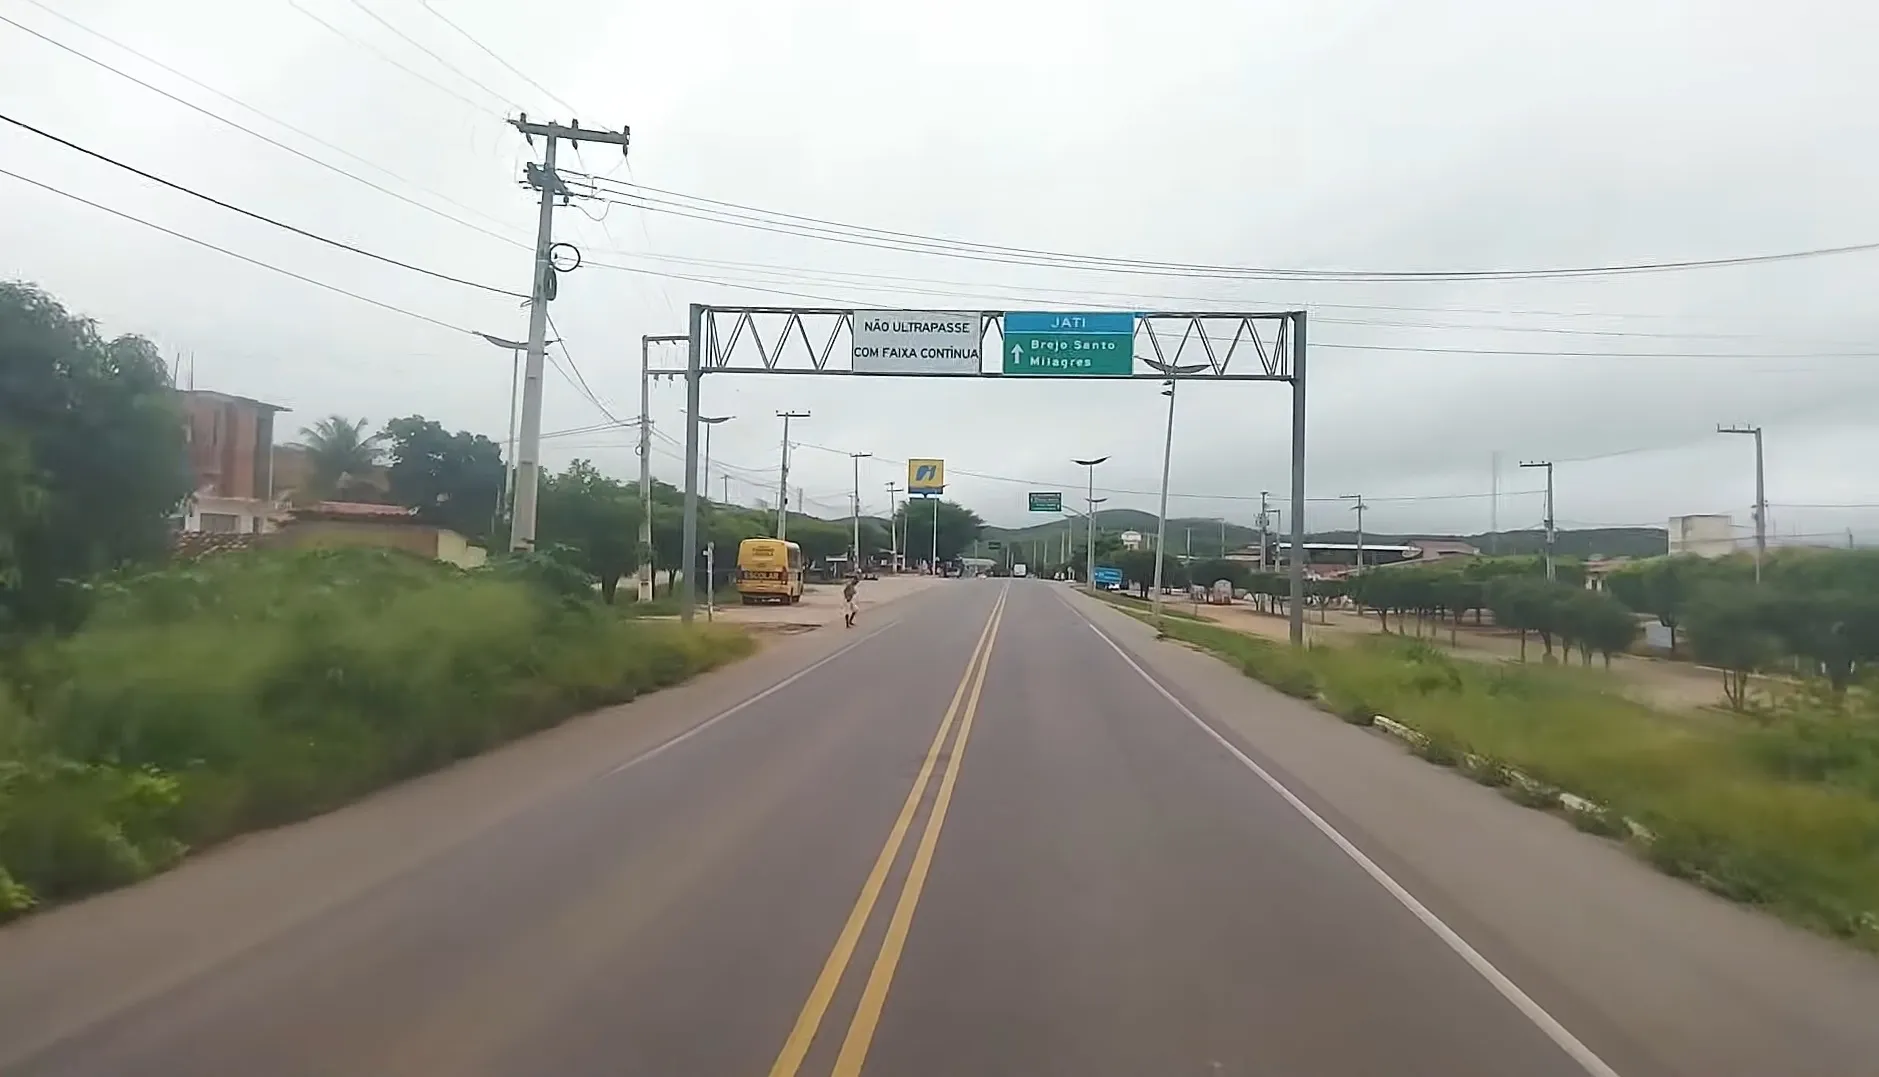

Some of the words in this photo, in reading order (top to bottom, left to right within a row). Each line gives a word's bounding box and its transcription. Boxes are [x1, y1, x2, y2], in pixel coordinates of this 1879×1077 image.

[864, 318, 889, 333] NÃO
[893, 321, 970, 334] ULTRAPASSE
[1050, 315, 1087, 329] JATI
[1031, 338, 1066, 351] Brejo
[1074, 340, 1116, 351] Santo
[854, 346, 878, 359] COM
[882, 346, 918, 359] FAIXA
[1030, 356, 1092, 369] Milagres
